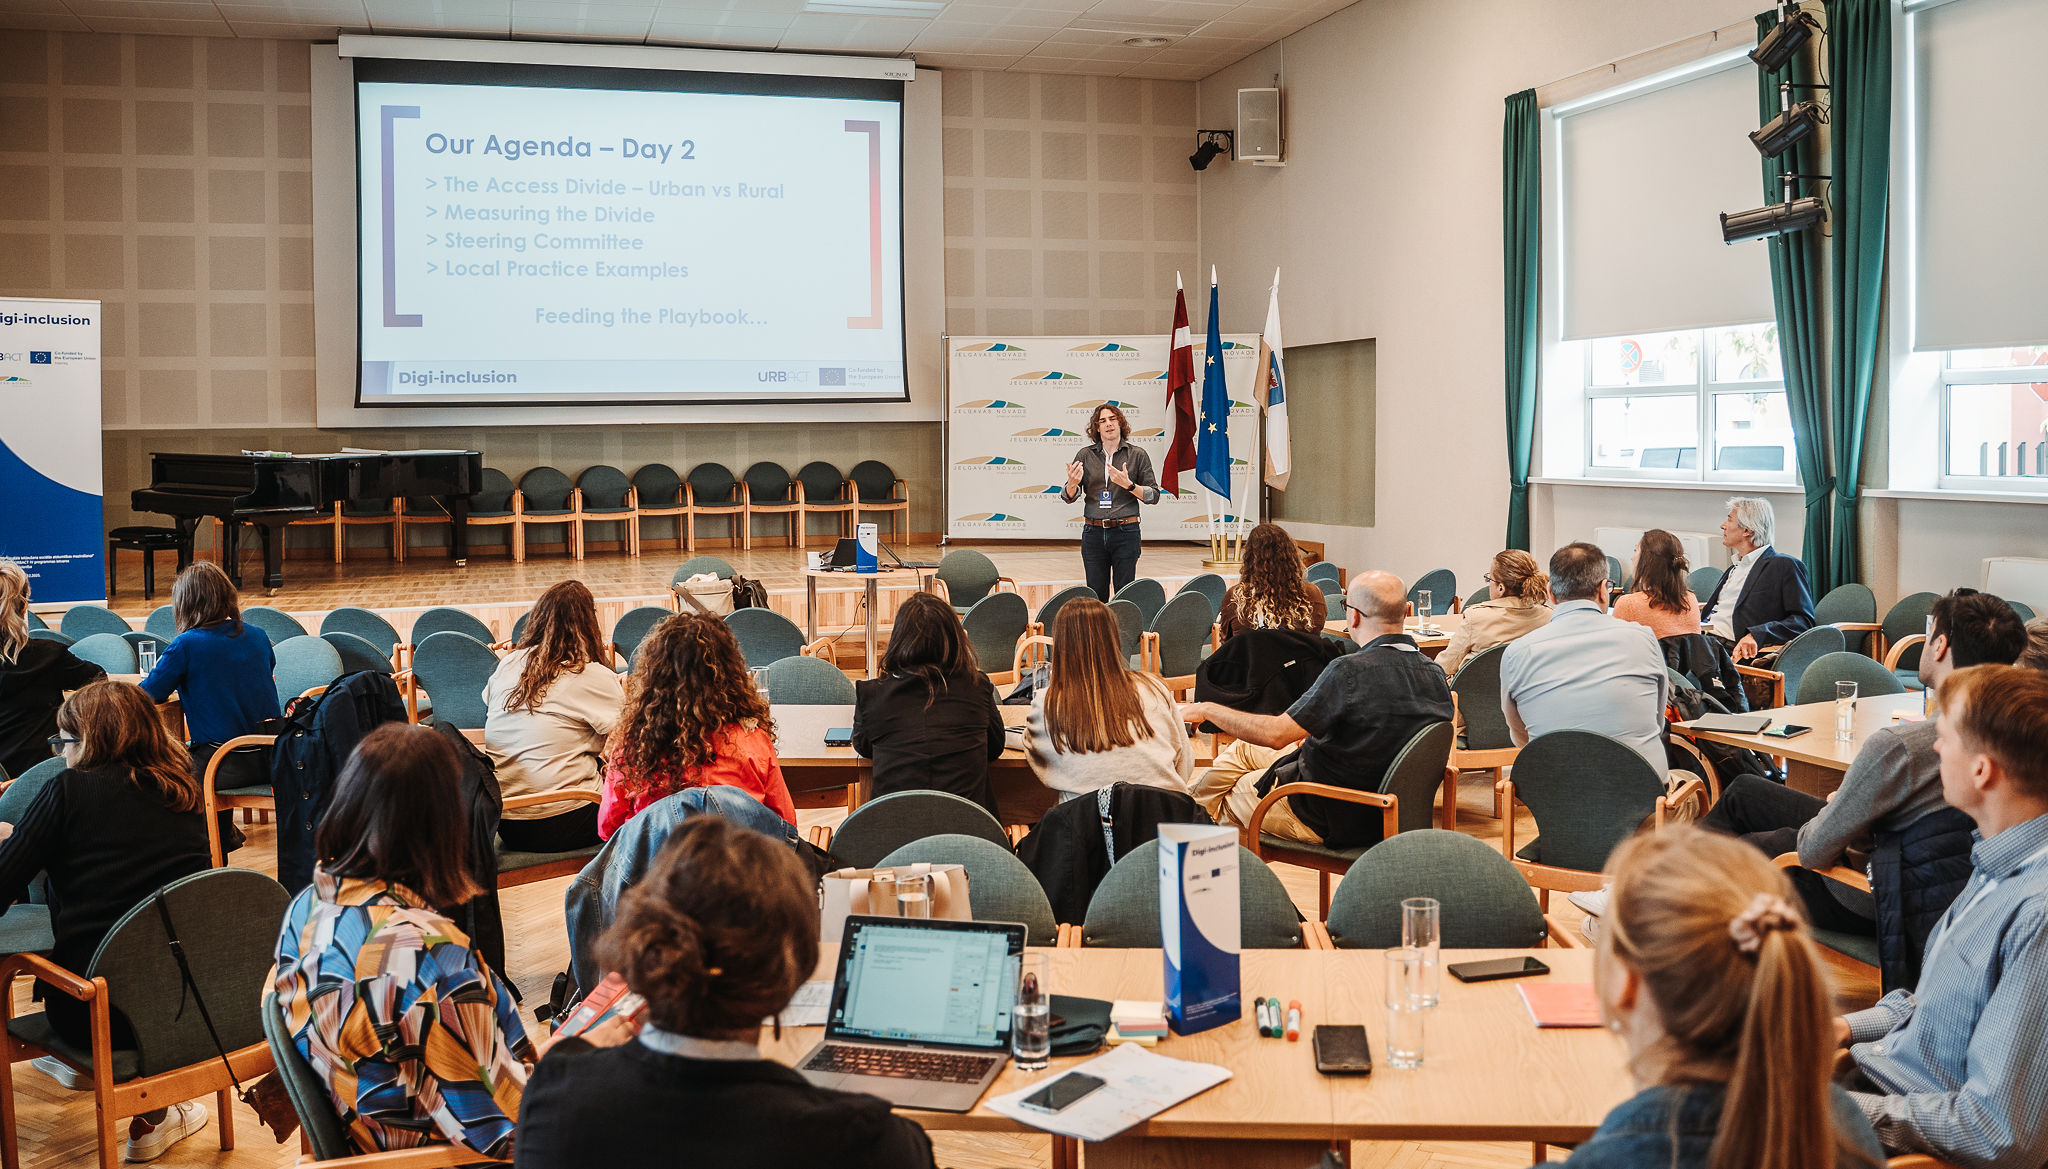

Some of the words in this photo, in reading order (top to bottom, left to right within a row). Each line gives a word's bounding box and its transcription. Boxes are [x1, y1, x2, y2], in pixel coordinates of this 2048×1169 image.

[426, 133, 475, 155] Our
[483, 135, 591, 162] Agenda
[623, 138, 672, 164] Day
[681, 139, 695, 160] 2
[444, 176, 479, 193] The
[486, 177, 558, 195] Access
[566, 178, 626, 196] Divide
[649, 180, 705, 197] Urban
[712, 186, 731, 198] vs
[738, 183, 783, 200] Rural
[445, 204, 549, 226] Measuring
[556, 205, 587, 222] the
[595, 206, 655, 223] Divide
[445, 232, 526, 253] Steering
[534, 233, 643, 251] Committee
[446, 260, 500, 277] Local
[508, 260, 588, 278] Practice
[596, 261, 688, 281] Examples
[0, 312, 90, 325] igi-inclusion
[536, 308, 614, 328] Feeding
[621, 307, 652, 324] the
[399, 368, 518, 387] Digi-inclusion
[758, 371, 809, 383] URBACT
